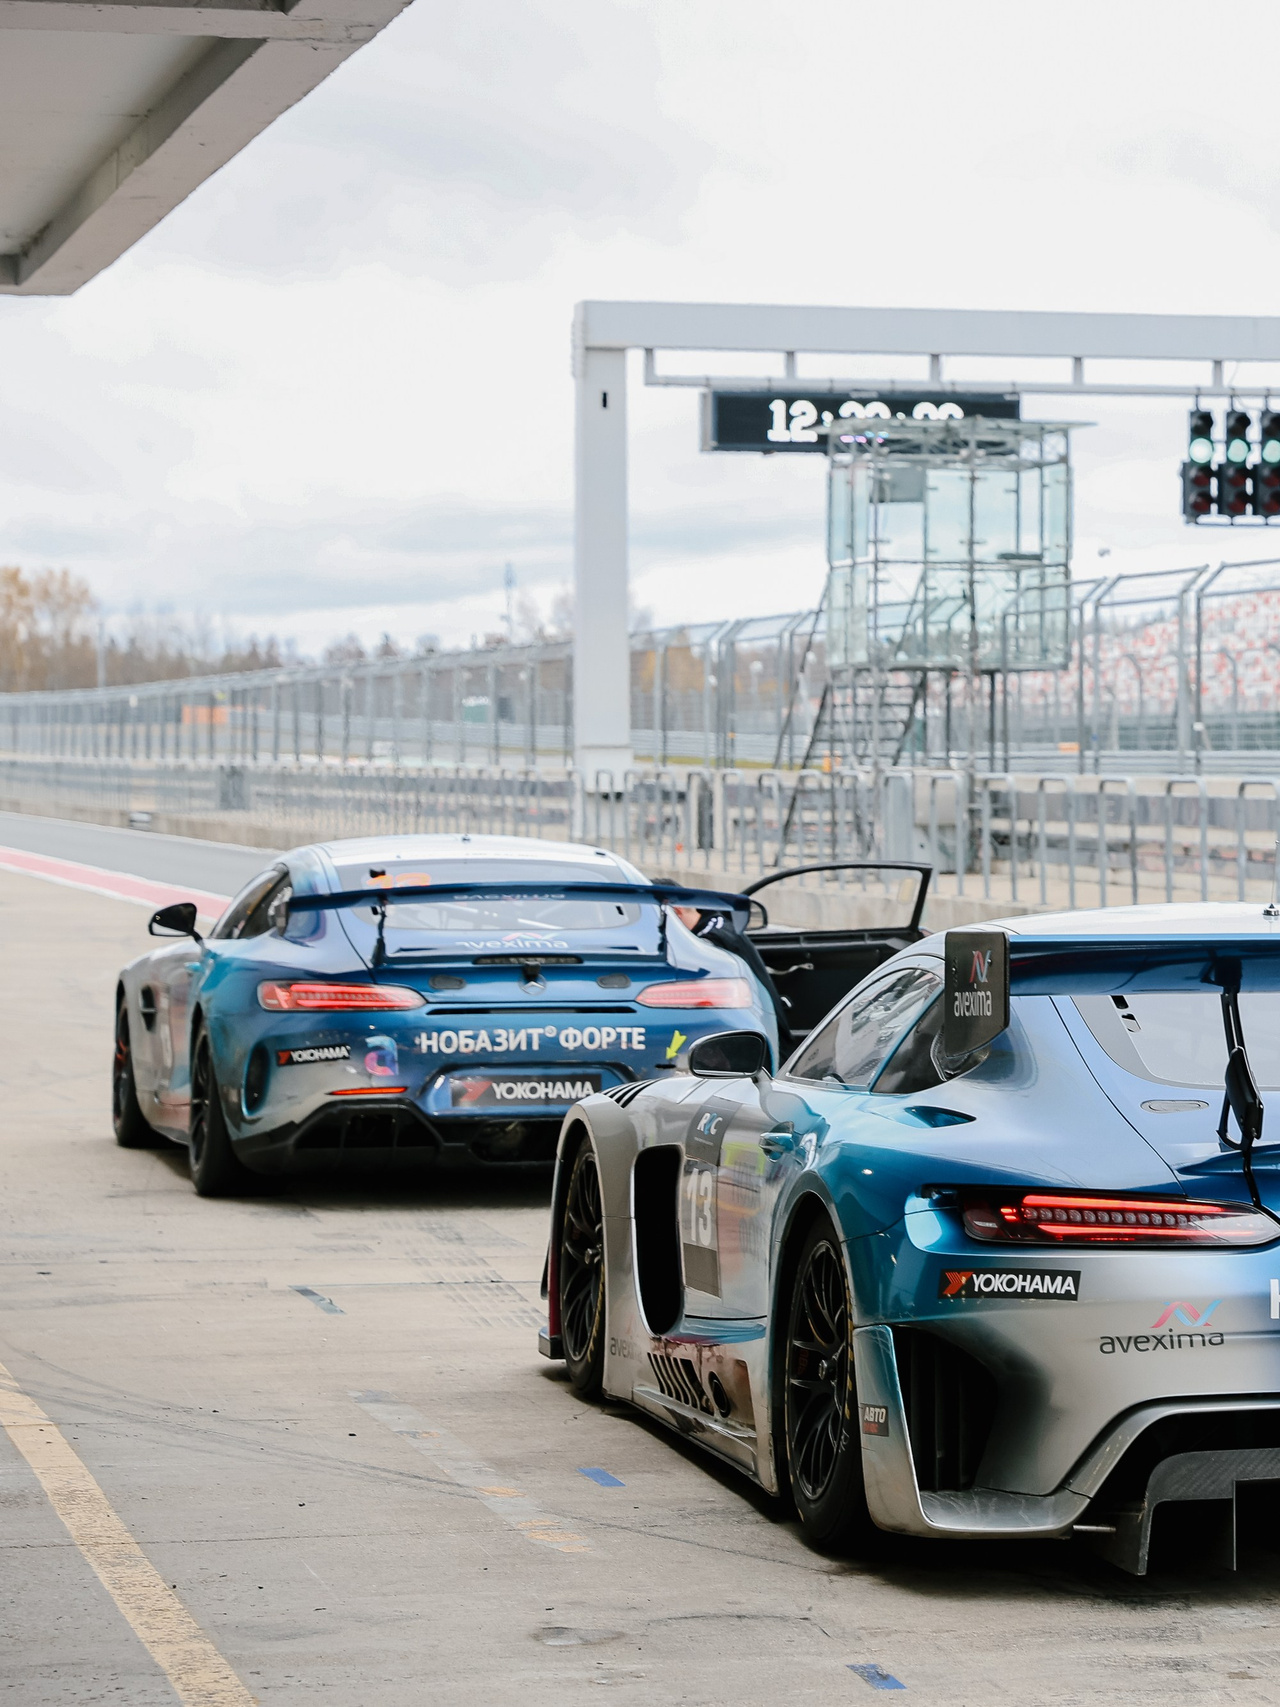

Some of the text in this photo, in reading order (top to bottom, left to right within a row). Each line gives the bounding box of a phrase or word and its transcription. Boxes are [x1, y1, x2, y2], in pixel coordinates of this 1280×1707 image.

[953, 982, 993, 1017] avexima
[558, 1026, 646, 1051] ФОРТЕ
[290, 1046, 351, 1063] YOKOHAMA
[491, 1080, 596, 1101] YOKOHAMA
[686, 1166, 713, 1247] 13
[971, 1273, 1077, 1296] YOKOHAMA
[1099, 1327, 1225, 1355] avexima
